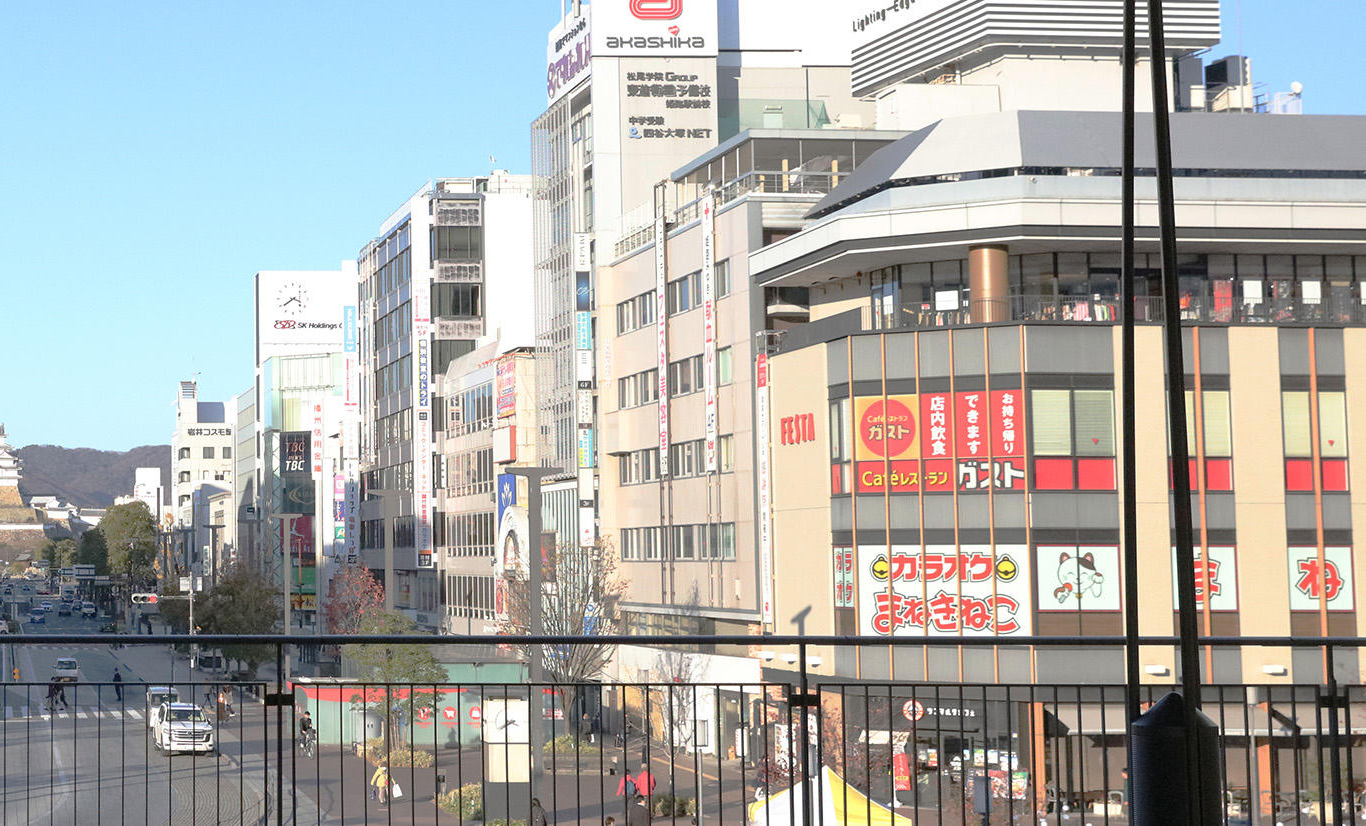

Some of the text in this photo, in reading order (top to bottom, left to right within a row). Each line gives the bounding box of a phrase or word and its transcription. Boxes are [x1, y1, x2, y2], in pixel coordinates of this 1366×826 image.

[606, 37, 705, 48] akashika
[627, 72, 664, 81] 松尾学院
[627, 85, 711, 97] 東進衛星予備校
[628, 116, 665, 125] 中学受験
[643, 129, 712, 139] 四谷大塚 NET
[781, 412, 815, 445] FESTA
[868, 425, 910, 441] ガスト
[930, 396, 947, 456] 店内飲食
[964, 394, 981, 455] できます
[1001, 393, 1015, 454] お持ち帰り
[285, 442, 305, 452] TBC
[313, 404, 322, 473] 播州信用金庫
[285, 460, 305, 471] TBC
[959, 460, 1025, 489] ガスト
[891, 553, 995, 581] カラオケ
[1299, 559, 1342, 600] ね
[874, 592, 1018, 634] まねきねこ
